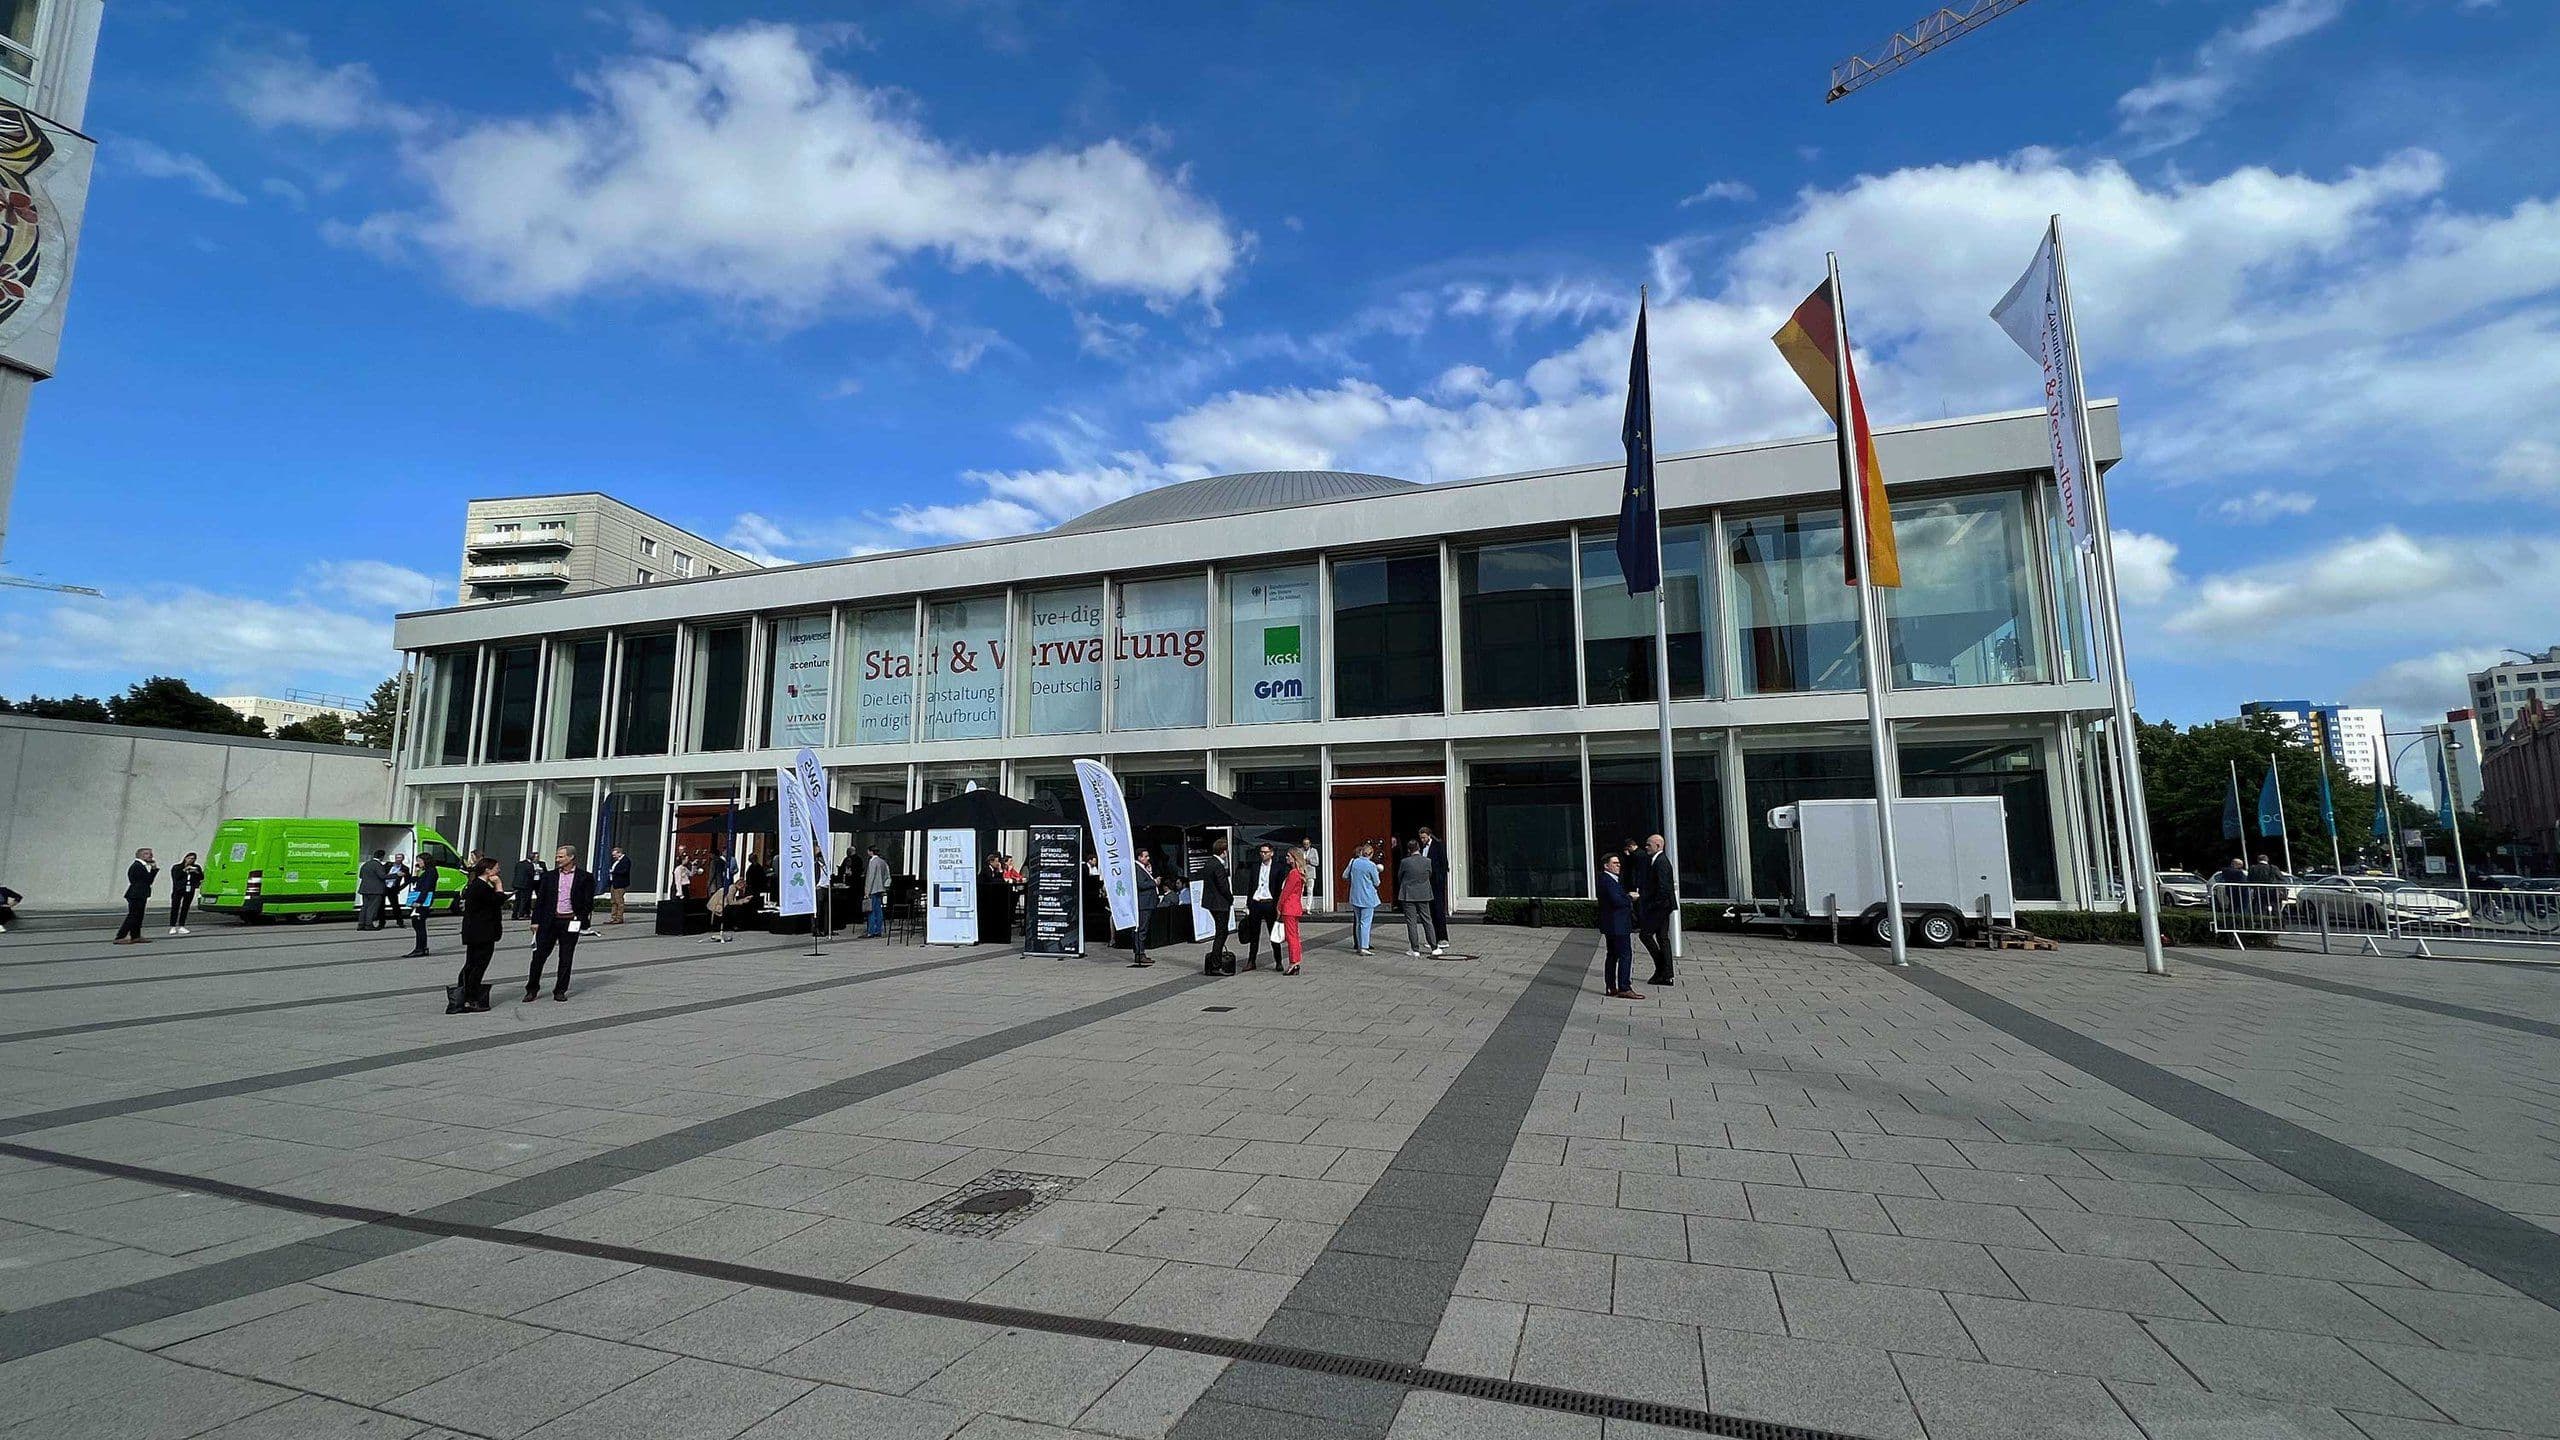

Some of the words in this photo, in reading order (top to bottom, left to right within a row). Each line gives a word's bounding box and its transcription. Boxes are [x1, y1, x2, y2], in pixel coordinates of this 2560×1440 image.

[2045, 378, 2057, 397] &
[2050, 400, 2075, 528] Verwaltung
[789, 659, 830, 670] accenture
[950, 640, 978, 673] &
[1266, 653, 1299, 666] KGSt
[863, 693, 883, 707] Die
[1032, 675, 1120, 695] Deutschlad
[786, 713, 826, 723] VITAKO
[862, 715, 877, 728] im
[936, 707, 997, 723] Aufbruch
